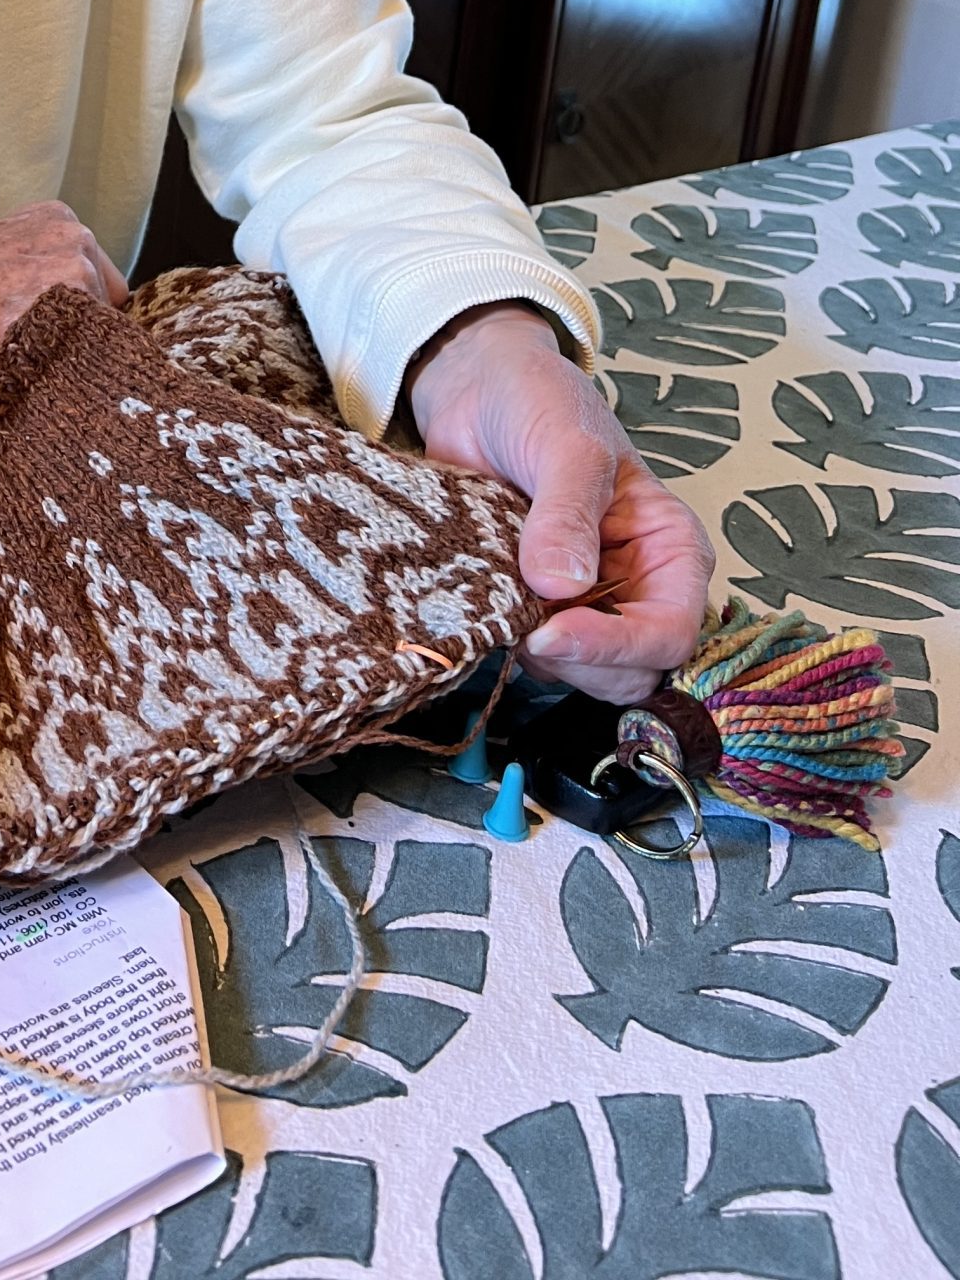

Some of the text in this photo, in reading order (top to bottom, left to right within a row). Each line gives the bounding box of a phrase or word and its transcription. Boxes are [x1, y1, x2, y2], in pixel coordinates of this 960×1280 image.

[63, 884, 88, 899] sts,
[27, 907, 42, 917] to
[40, 894, 66, 911] join
[74, 896, 97, 911] CO
[49, 908, 73, 924] 100
[76, 906, 108, 923] With
[15, 917, 49, 937] (106,
[53, 919, 78, 936] MC
[81, 916, 117, 935] Yoke
[23, 929, 54, 948] yarn
[52, 926, 128, 967] Instructions
[123, 955, 158, 975] hem.
[136, 967, 168, 985] then
[72, 975, 124, 1005] Sleeves
[114, 982, 139, 998] the
[146, 979, 177, 999] right
[48, 1002, 72, 1016] are
[82, 995, 116, 1018] body
[105, 993, 149, 1021] before
[152, 992, 187, 1012] short
[0, 1013, 49, 1042] worked
[68, 1013, 83, 1024] is
[120, 1006, 154, 1029] rows
[150, 1006, 197, 1032] worked
[19, 1020, 69, 1050] worked
[62, 1018, 106, 1045] sleeve
[97, 1025, 121, 1042] are
[128, 1026, 152, 1042] top
[152, 1025, 193, 1047] create
[4, 1043, 20, 1055] in
[48, 1039, 98, 1071] worked
[90, 1039, 128, 1064] down
[140, 1043, 152, 1053] a
[152, 1045, 190, 1065] some
[75, 1060, 92, 1073] to
[99, 1049, 143, 1079] higher
[29, 1092, 64, 1116] neck
[58, 1101, 83, 1120] are
[0, 1112, 29, 1133] and
[47, 1097, 123, 1146] seamlessly
[6, 1116, 59, 1150] worked
[12, 1141, 48, 1164] from
